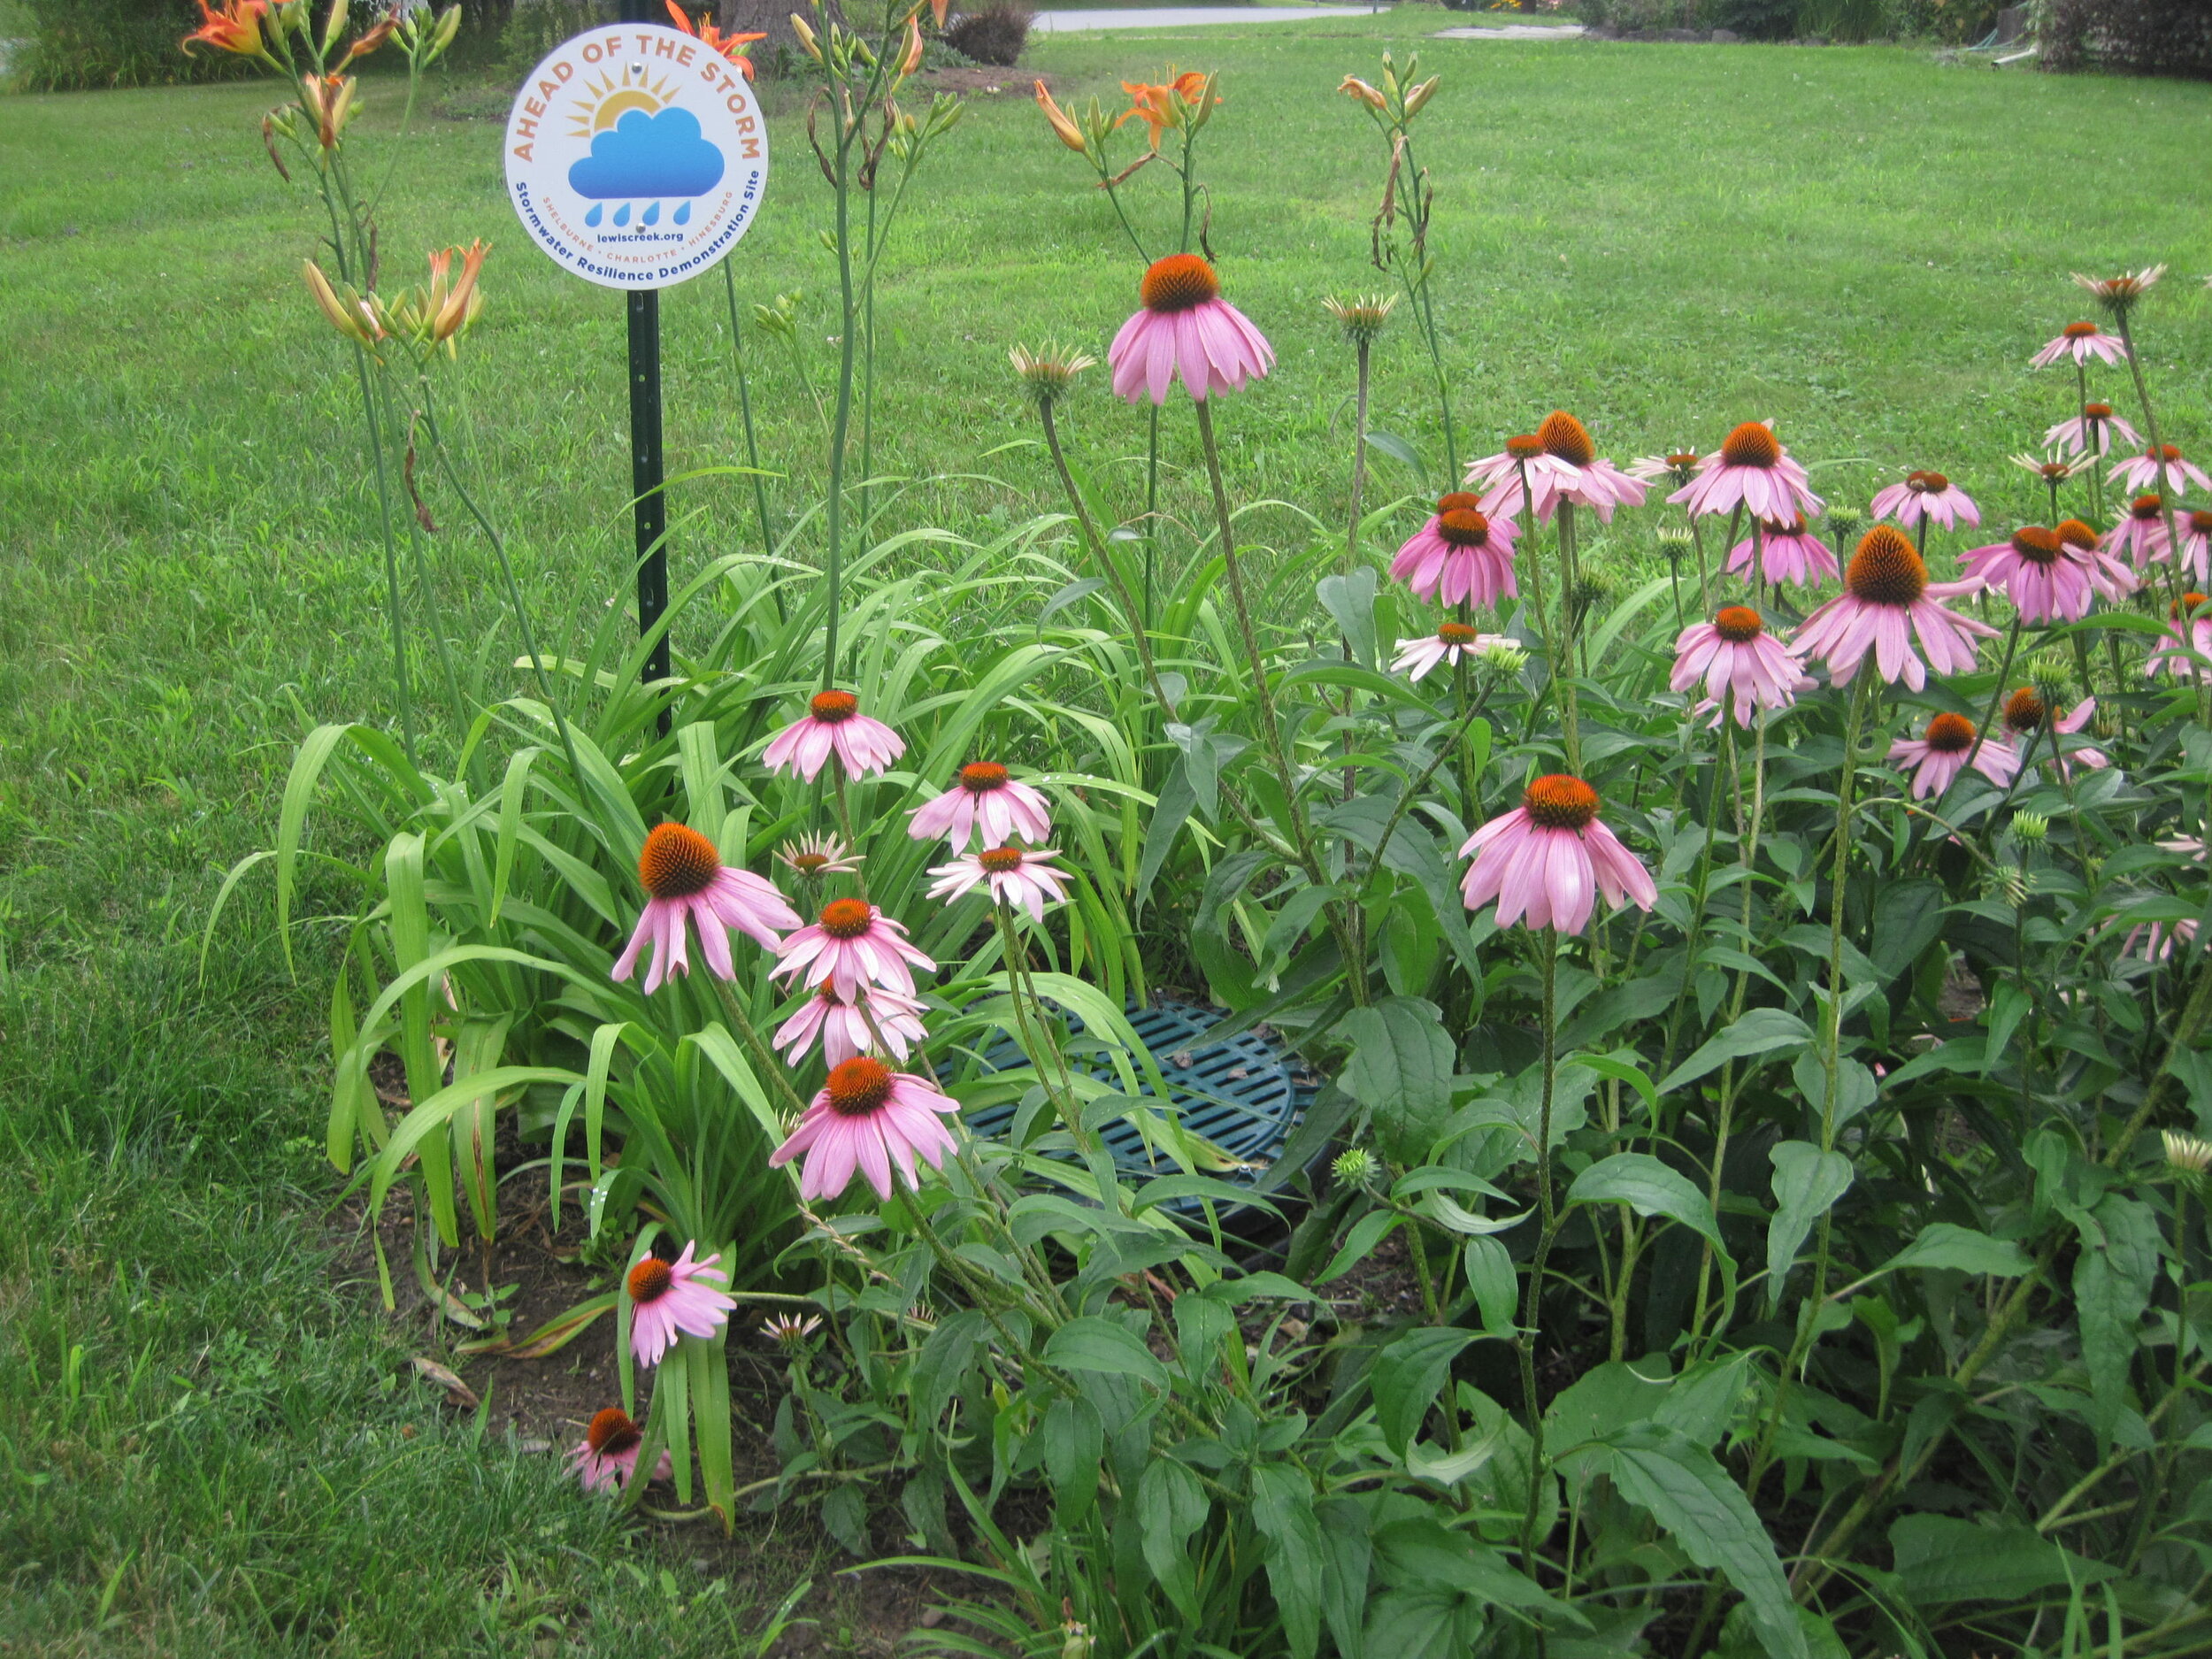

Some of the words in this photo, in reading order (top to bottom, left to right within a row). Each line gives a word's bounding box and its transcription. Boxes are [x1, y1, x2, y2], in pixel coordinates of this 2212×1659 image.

[514, 62, 573, 162] AHEAD
[582, 36, 622, 63] OF
[636, 35, 695, 66] THE
[701, 63, 760, 159] STORM
[517, 182, 573, 260] Stormwater
[578, 257, 654, 280] Resilience
[659, 204, 749, 279] Demonstration
[745, 170, 759, 200] Site
[543, 196, 594, 252] SHELBURNE
[607, 250, 677, 263] CHARLOTTE
[689, 192, 733, 246] HINESBURG
[597, 231, 683, 242] lewiscreek.org
